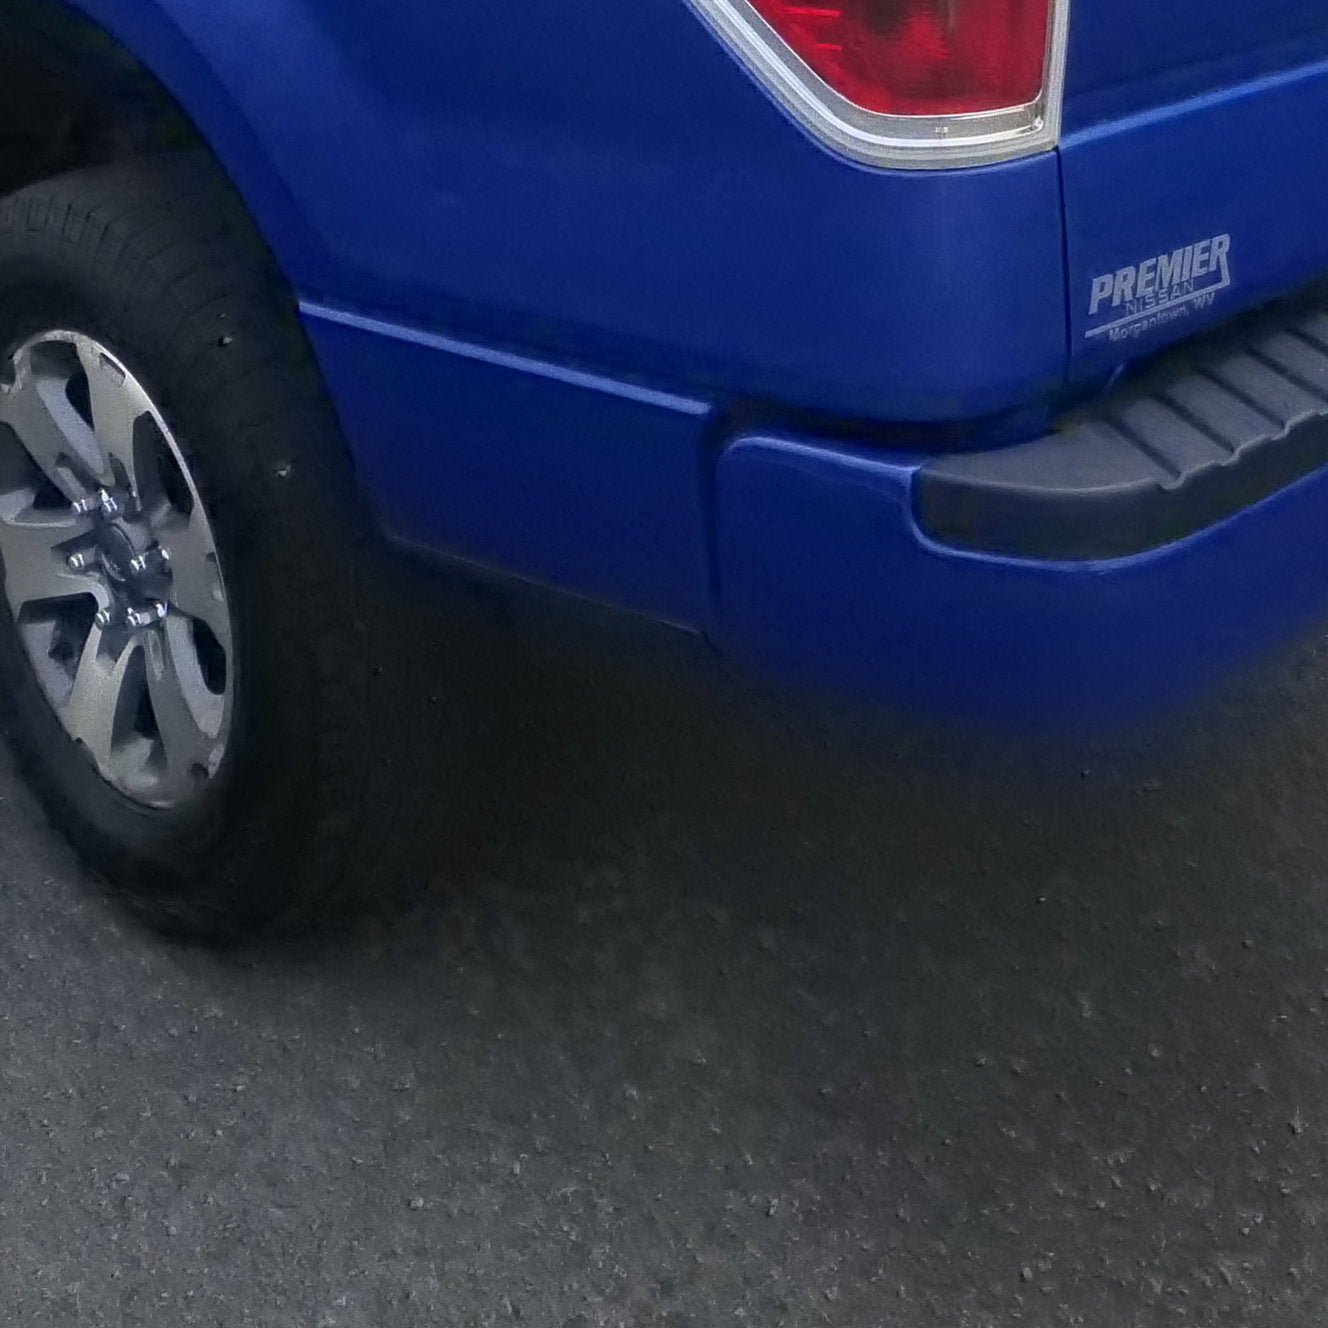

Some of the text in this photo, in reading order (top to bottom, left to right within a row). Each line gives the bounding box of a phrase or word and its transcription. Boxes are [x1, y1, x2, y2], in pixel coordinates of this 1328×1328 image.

[1087, 233, 1231, 316] PREMIER
[1125, 279, 1195, 315] NISSAN
[1192, 291, 1216, 311] WV
